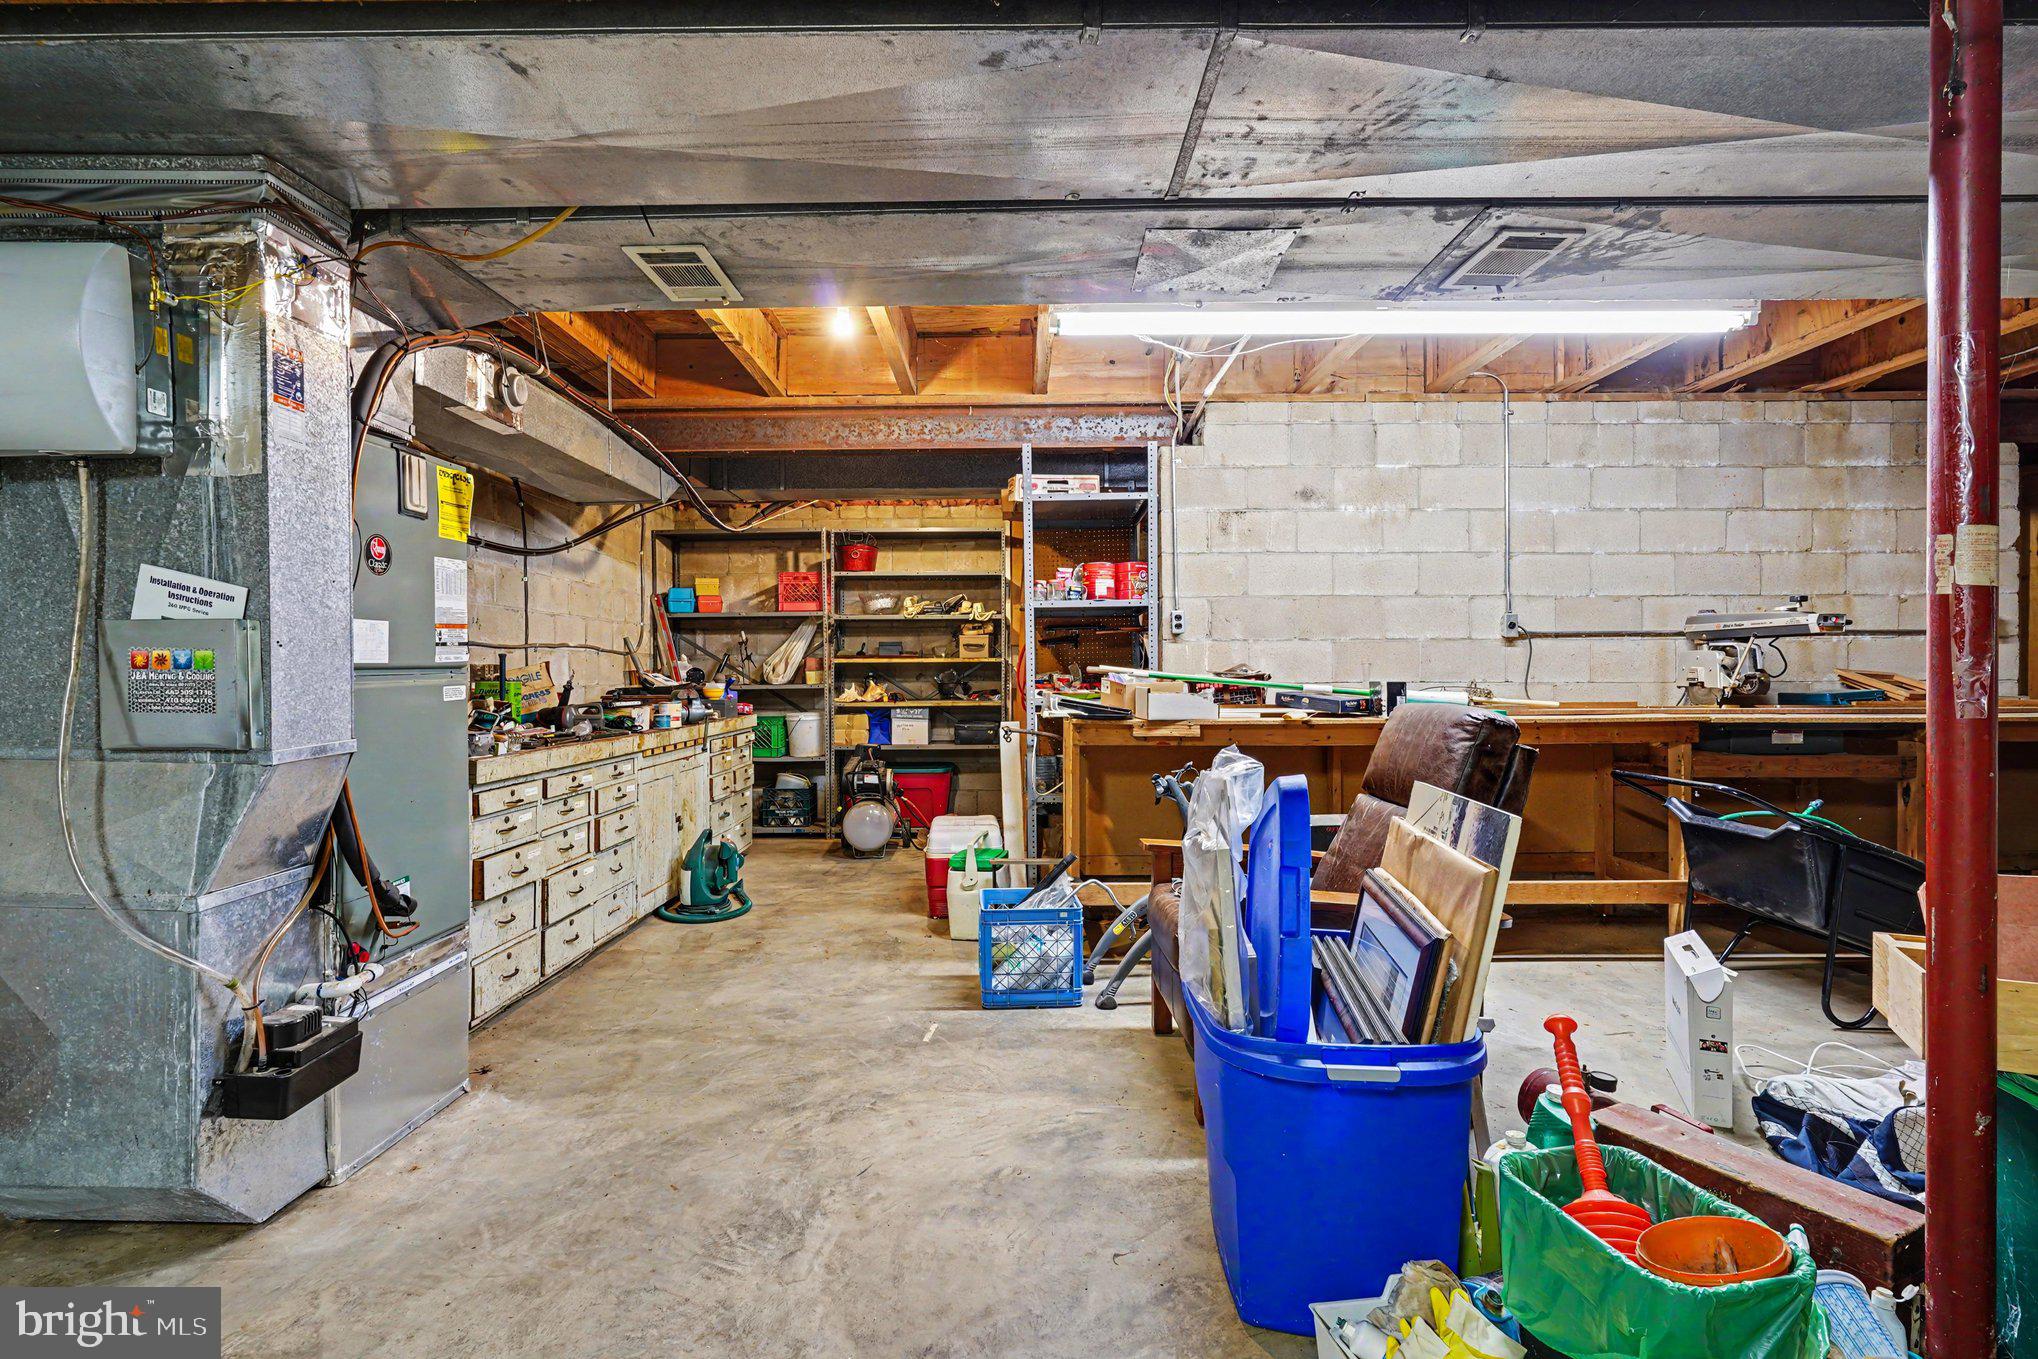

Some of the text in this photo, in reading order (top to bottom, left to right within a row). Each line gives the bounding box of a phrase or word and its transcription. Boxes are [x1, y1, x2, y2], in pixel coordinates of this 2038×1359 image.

[149, 575, 235, 603] Installation & Operation
[167, 590, 213, 608] Instructions
